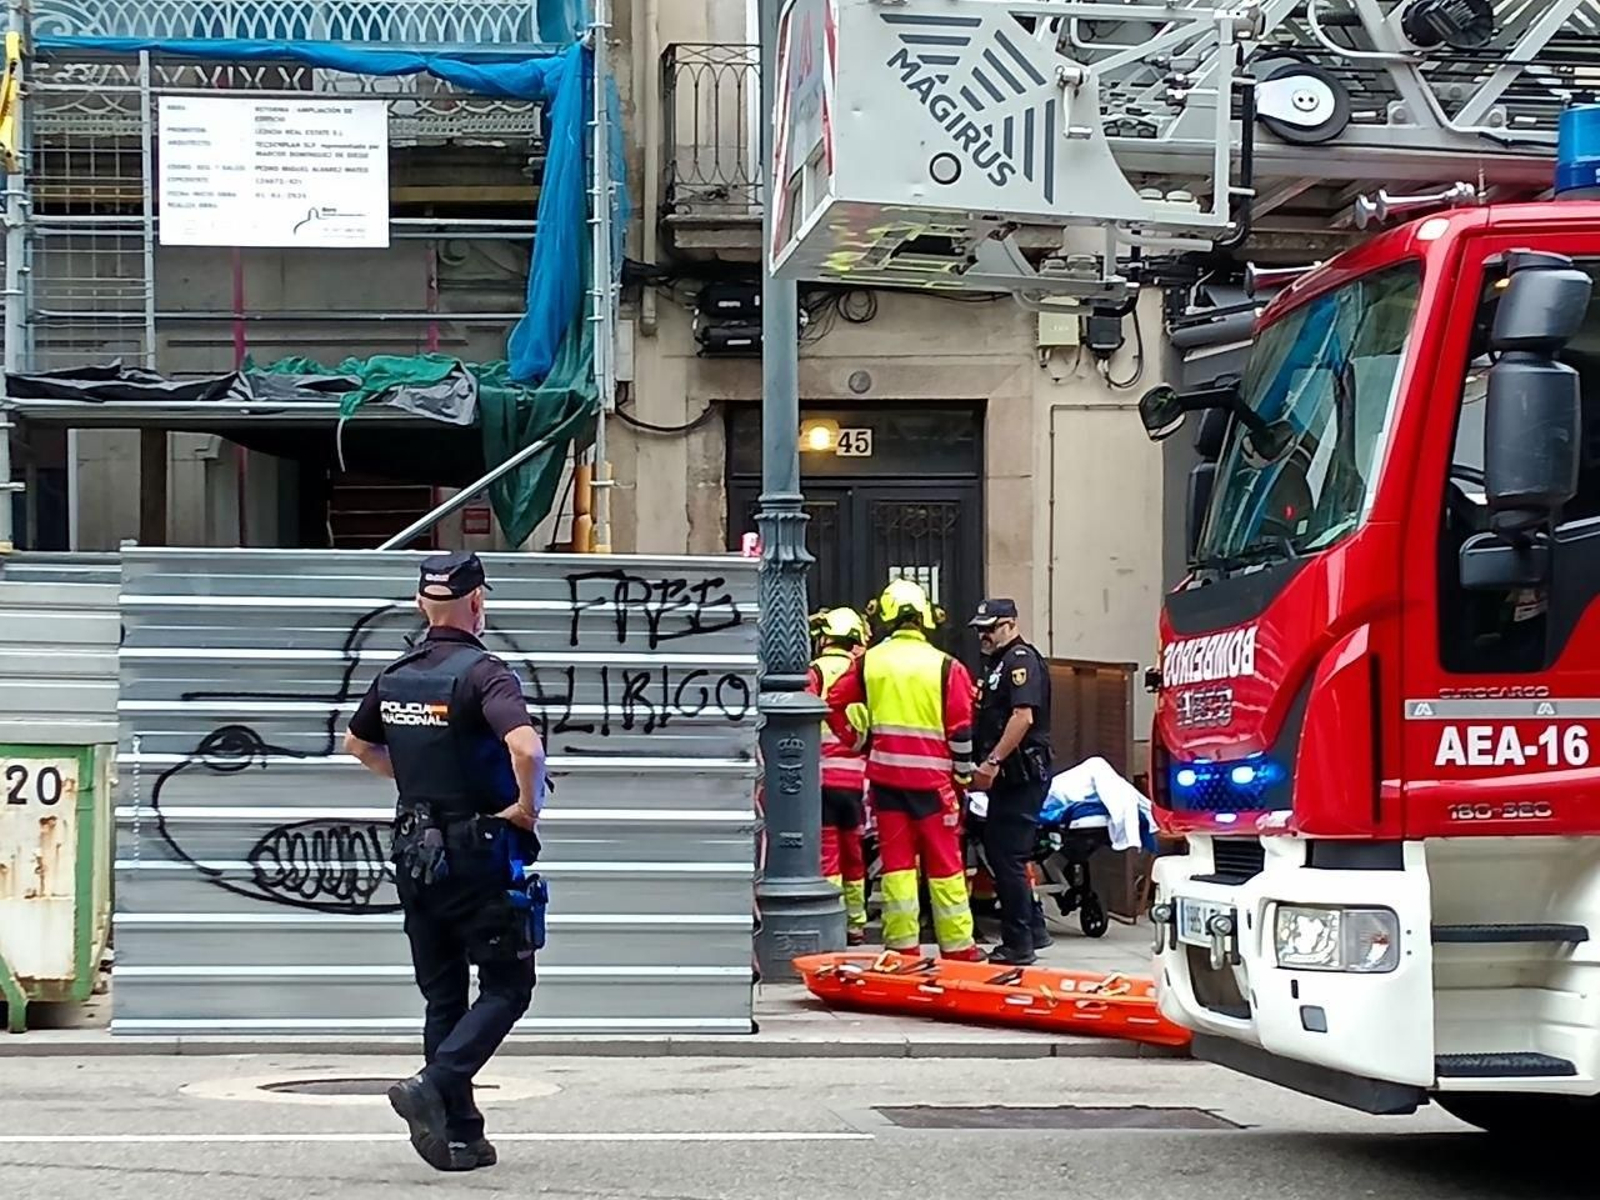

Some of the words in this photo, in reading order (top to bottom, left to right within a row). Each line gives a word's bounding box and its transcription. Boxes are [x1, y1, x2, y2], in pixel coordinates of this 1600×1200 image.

[886, 47, 1016, 187] MAGIRUS
[838, 431, 869, 453] 45
[565, 569, 743, 650] FREE
[1434, 724, 1590, 767] AEA-16
[5, 764, 62, 806] 20
